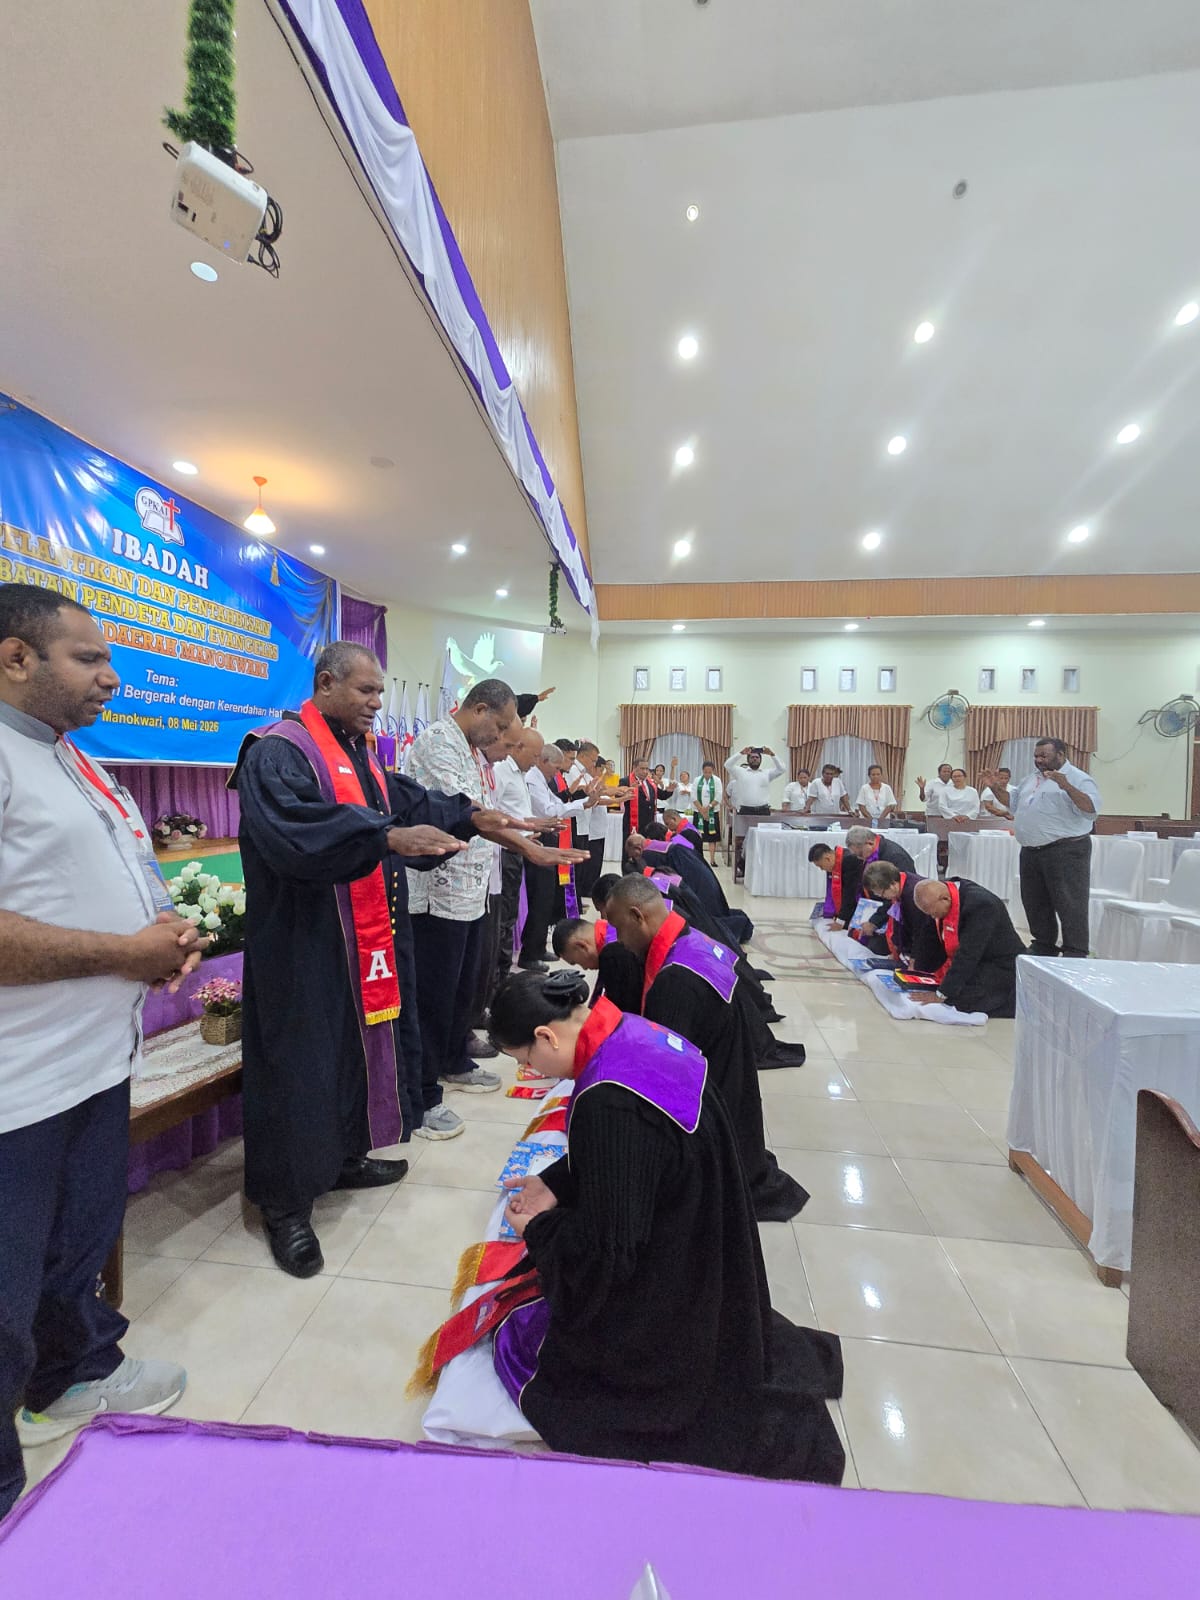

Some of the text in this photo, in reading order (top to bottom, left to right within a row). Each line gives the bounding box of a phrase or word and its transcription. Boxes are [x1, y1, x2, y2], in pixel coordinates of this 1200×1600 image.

[0, 522, 272, 638] ELANTIKAN DAN PENTAHBISAN
[112, 528, 209, 589] IBADAH
[81, 585, 171, 630] PENDETA
[173, 613, 207, 640] DAN
[208, 624, 279, 660] EVANGELIS
[102, 620, 269, 679] DAERAH MANOKWARI
[124, 684, 177, 705] Bergerak
[179, 694, 215, 711] dengan
[217, 700, 267, 717] Kerendahan
[268, 707, 285, 719] Hat
[146, 669, 180, 687] Tema:
[102, 710, 219, 733] Manokwari, 08 Mei 2026
[366, 950, 393, 981] A
